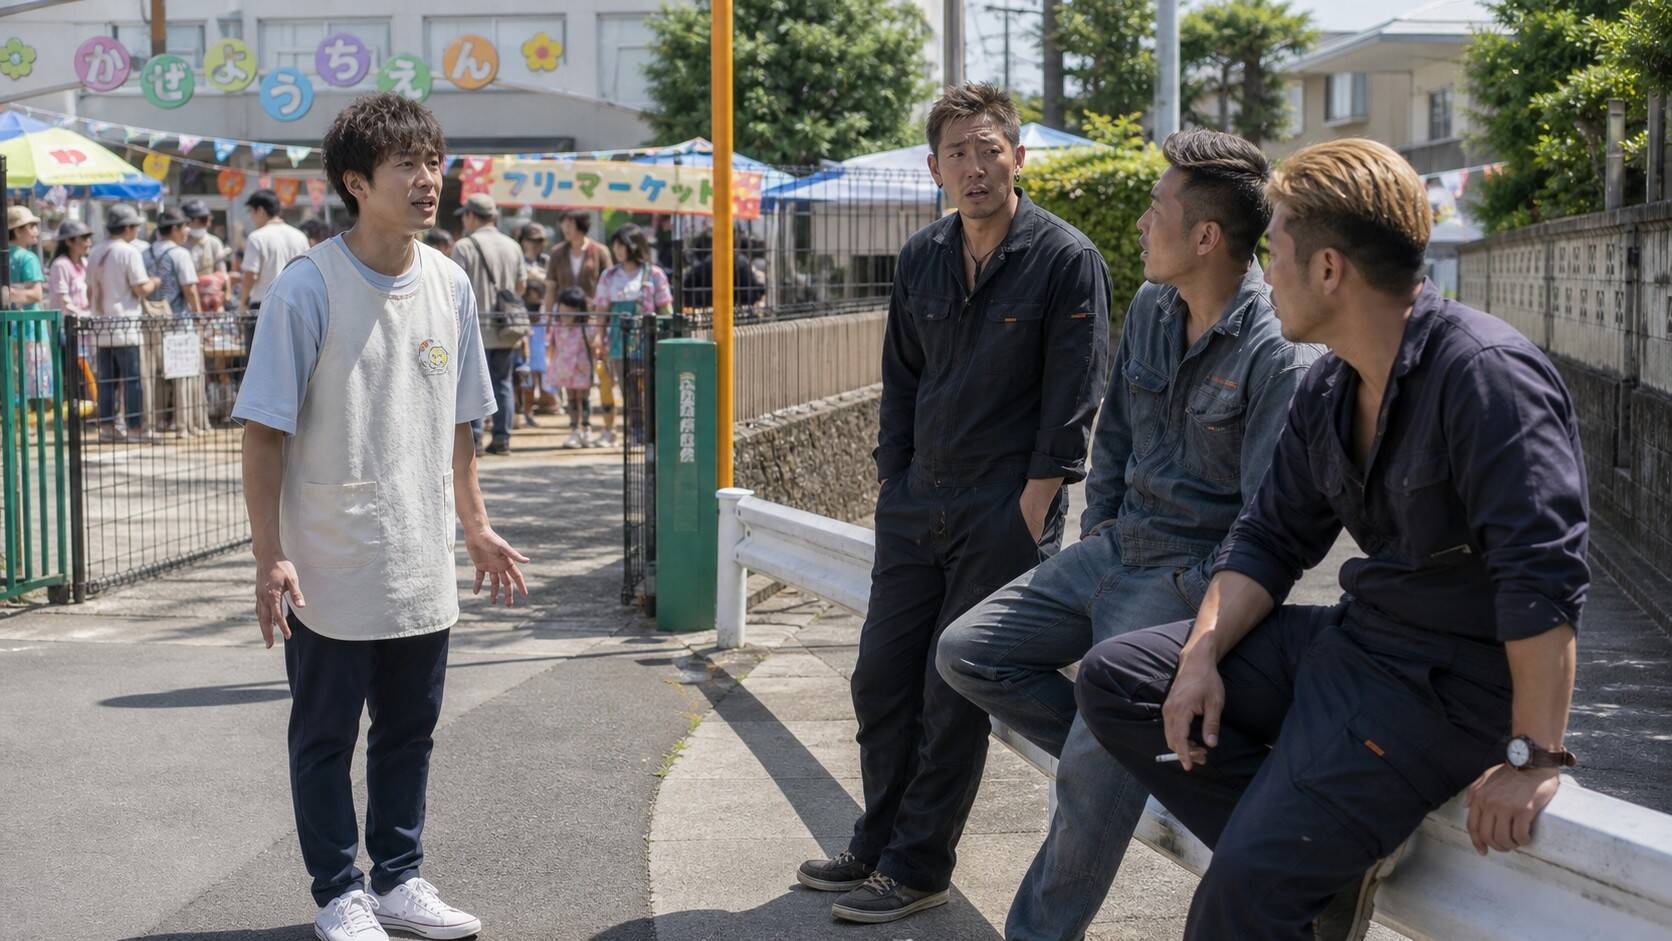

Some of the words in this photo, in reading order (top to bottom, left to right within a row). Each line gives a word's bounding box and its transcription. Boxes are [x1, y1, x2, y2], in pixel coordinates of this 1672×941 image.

[84, 38, 492, 115] かぜようちえん
[503, 171, 714, 204] フリーマーケット
